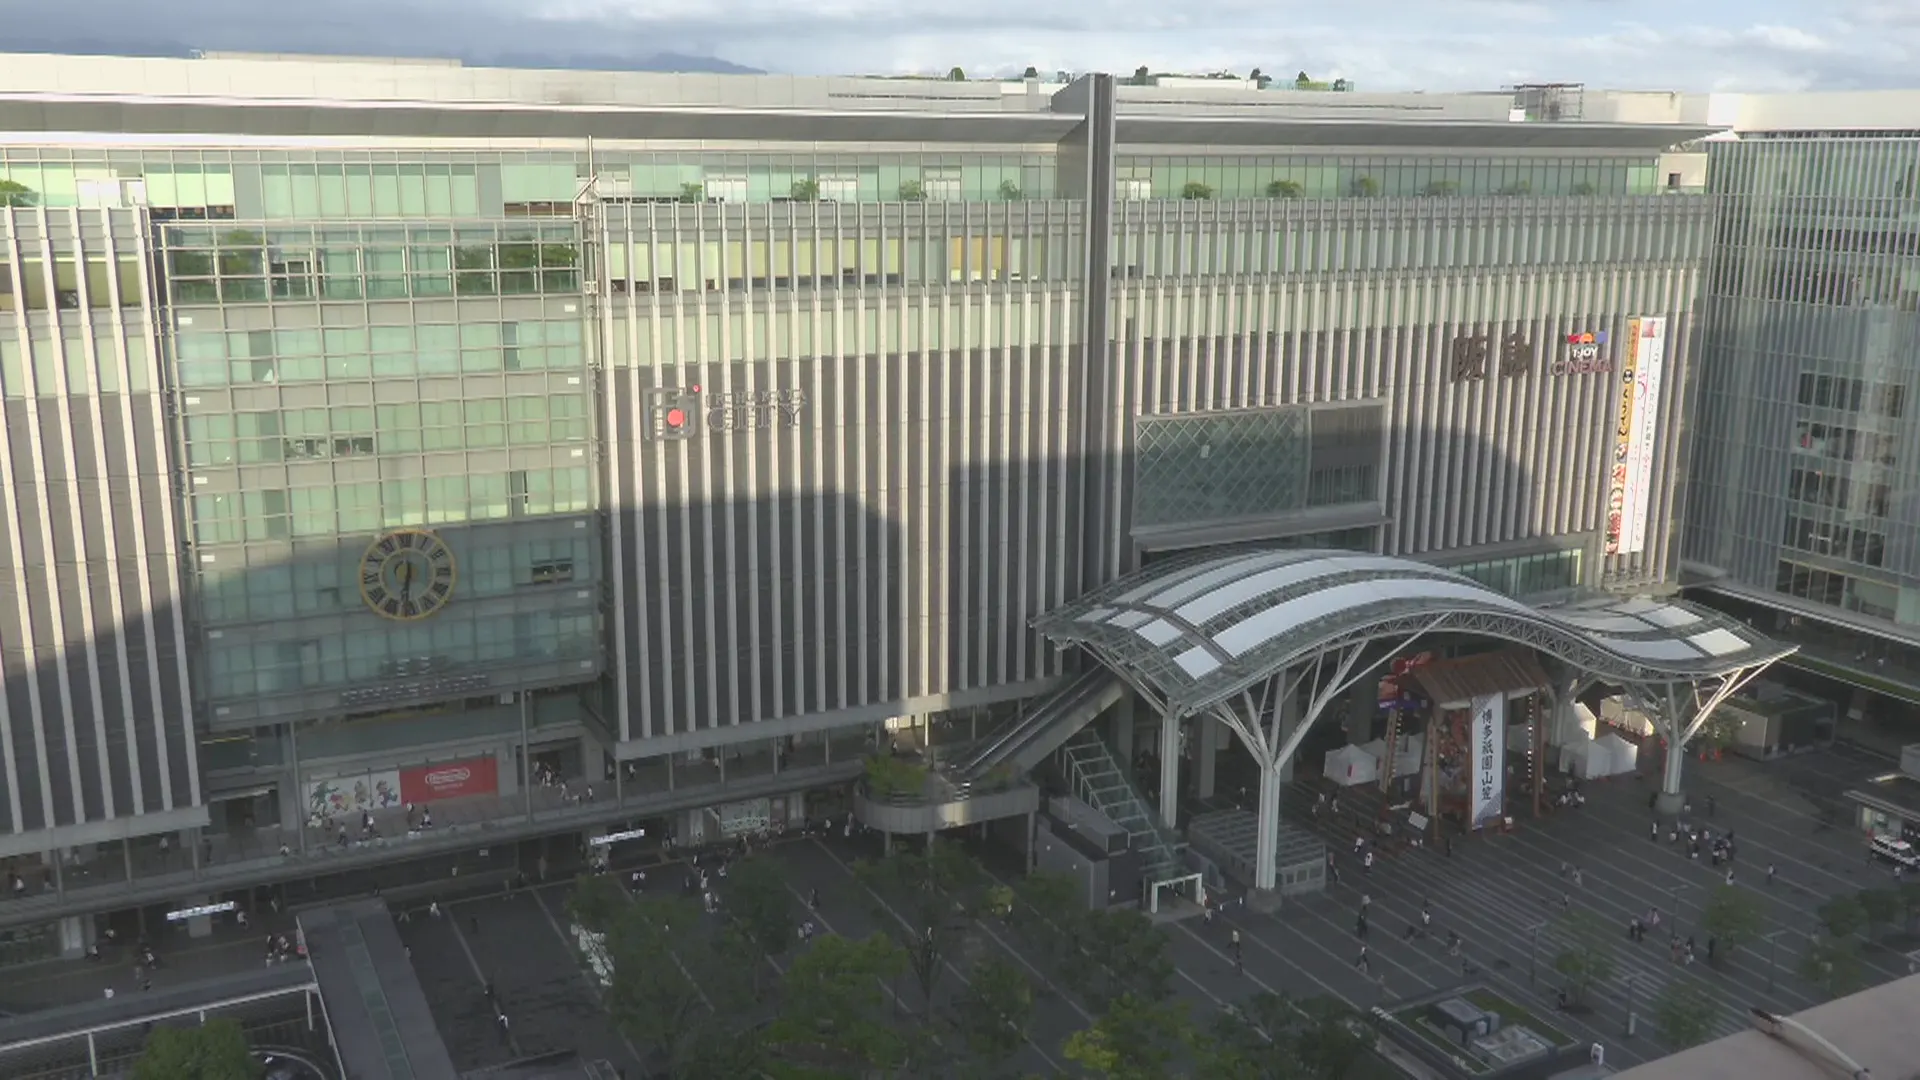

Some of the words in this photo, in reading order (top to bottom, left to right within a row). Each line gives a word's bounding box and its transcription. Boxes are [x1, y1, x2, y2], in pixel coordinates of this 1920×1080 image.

[1452, 334, 1530, 381] 阪急
[1552, 359, 1613, 376] CINEMA
[708, 404, 803, 431] CITY
